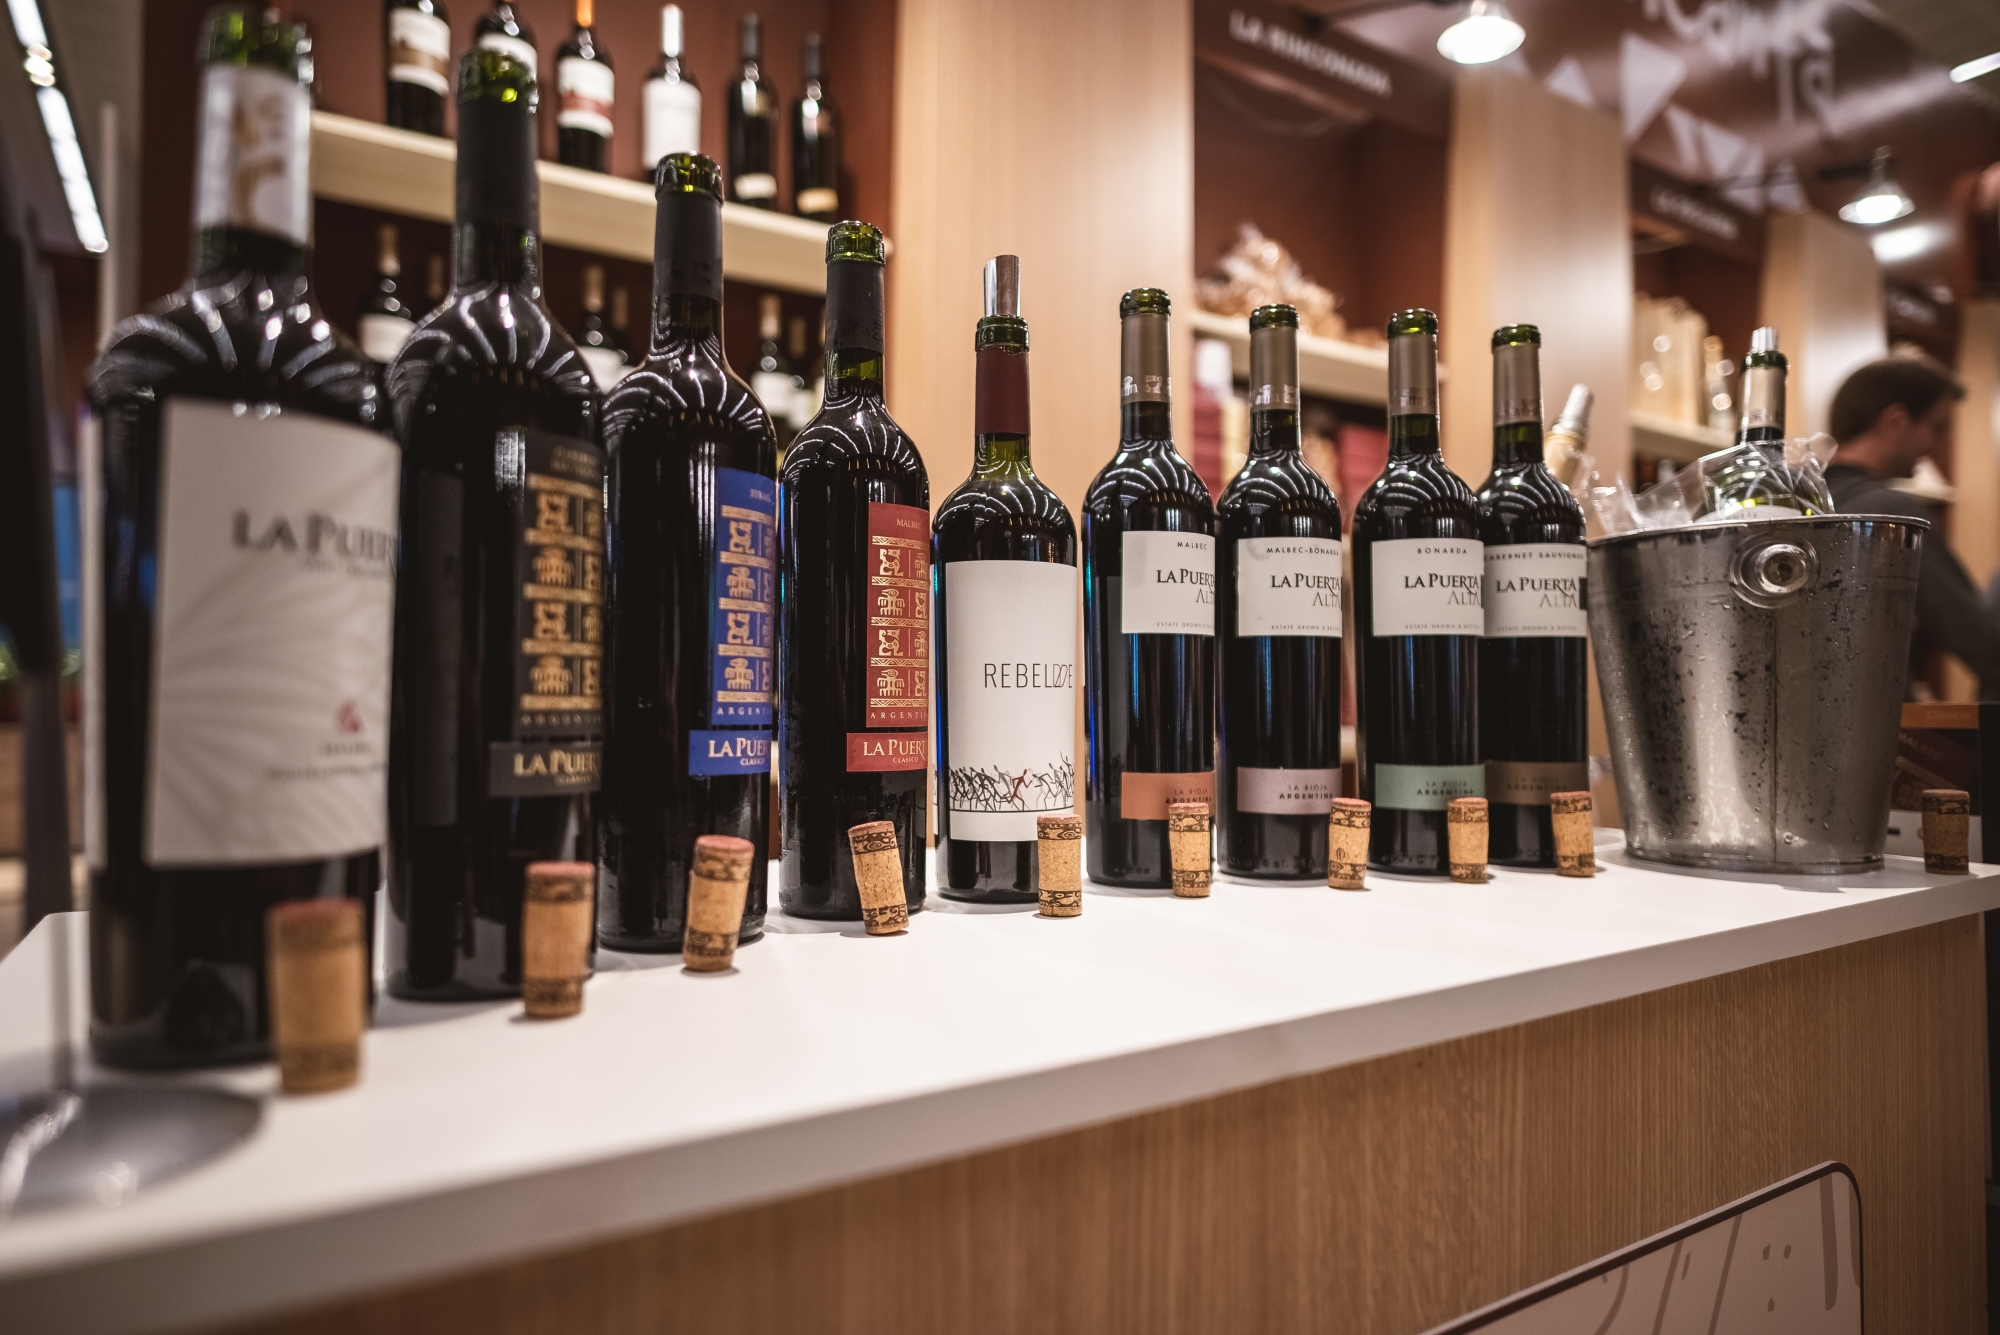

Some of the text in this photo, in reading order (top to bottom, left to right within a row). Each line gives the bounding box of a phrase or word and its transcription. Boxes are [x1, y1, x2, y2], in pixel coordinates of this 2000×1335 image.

[1229, 10, 1264, 46] LA
[232, 509, 299, 553] LA
[896, 518, 922, 529] MALBEC
[1177, 541, 1208, 551] MALBEC
[1266, 546, 1339, 556] MALBEC-BONARDA
[1417, 547, 1468, 555] BONARDA
[1156, 569, 1178, 584] LA
[1270, 572, 1341, 597] LA PUERTA
[1404, 572, 1480, 597] LA PUERTA
[1496, 576, 1577, 597] LA PUERTA
[1312, 591, 1341, 608] ALTA
[1447, 590, 1480, 606] ALTA
[1538, 592, 1577, 609] ALTA
[708, 740, 734, 758] LA
[863, 741, 886, 756] LA
[513, 752, 548, 777] LA
[892, 756, 919, 764] CLASICO
[1174, 787, 1208, 796] LA RIOJA
[1288, 784, 1300, 792] LA
[1426, 780, 1438, 788] LA
[1279, 792, 1334, 800] ARGENTINA
[1417, 788, 1474, 796] ARGENTINA
